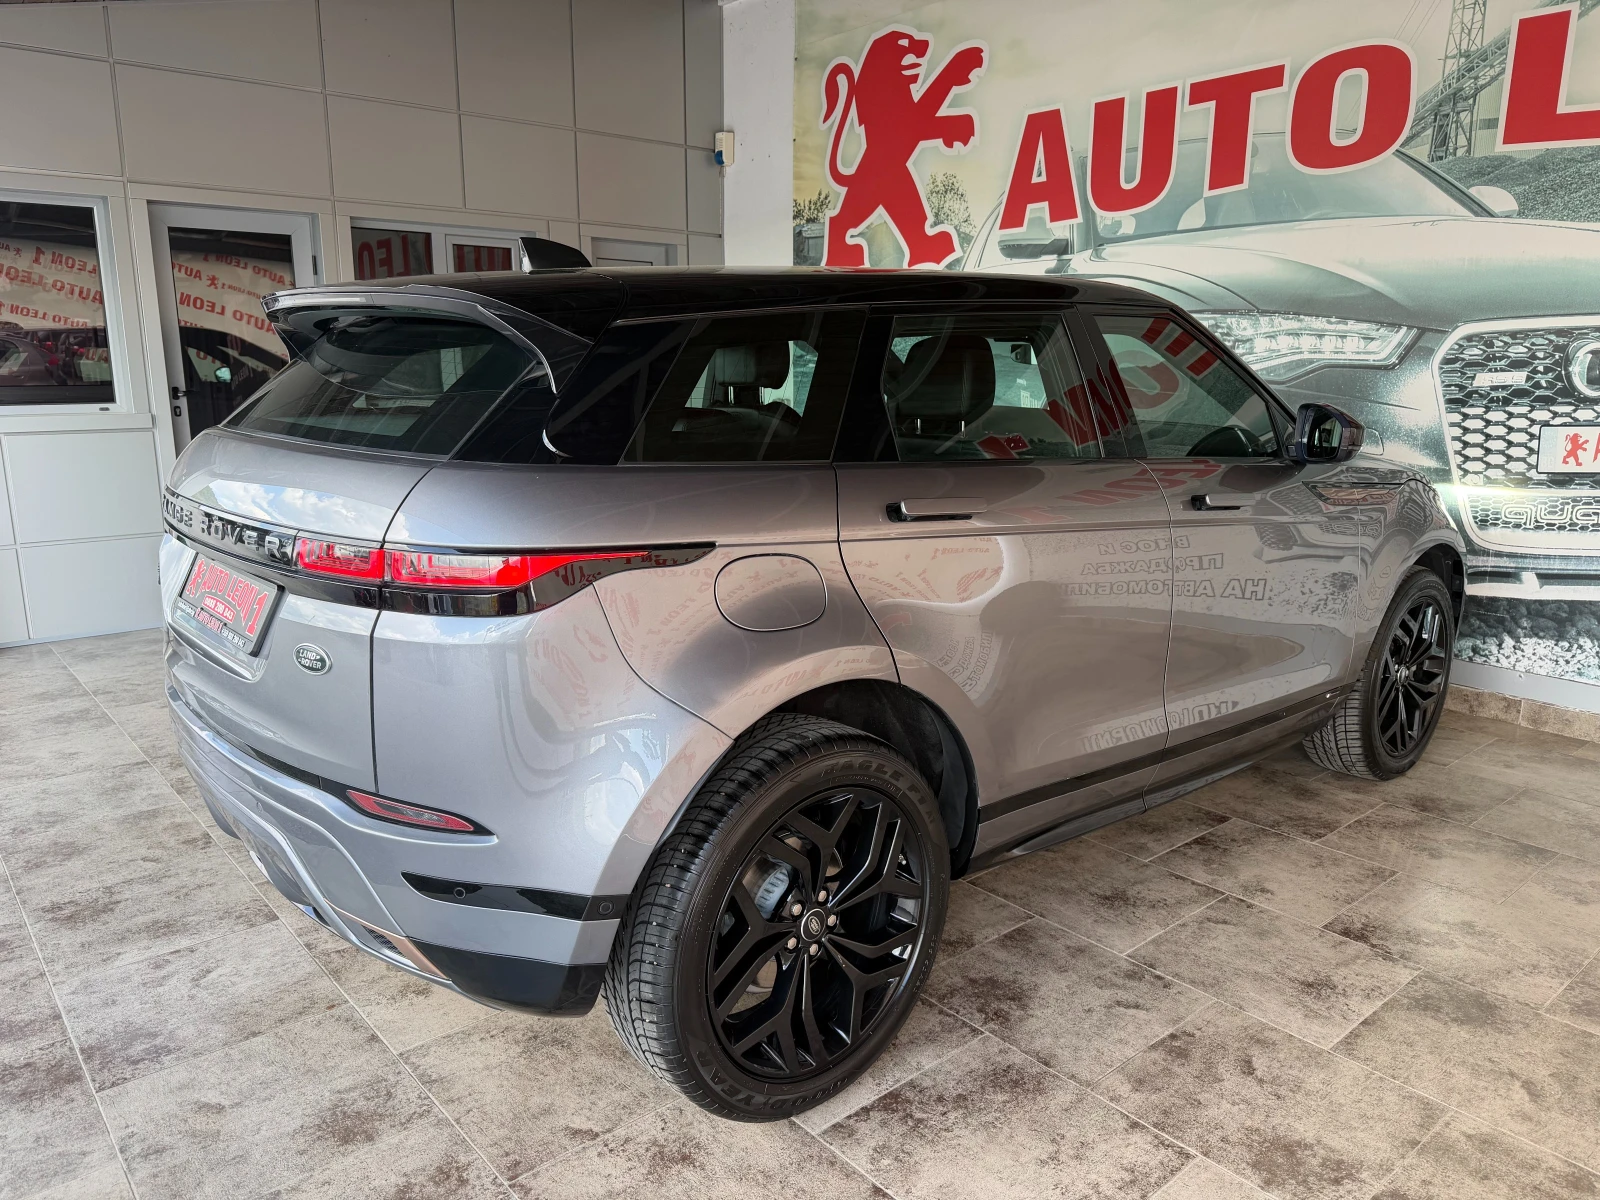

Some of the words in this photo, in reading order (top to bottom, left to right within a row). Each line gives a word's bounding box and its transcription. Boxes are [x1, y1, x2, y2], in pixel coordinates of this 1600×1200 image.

[997, 40, 1414, 232] AUTO
[1500, 8, 1600, 147] L
[200, 516, 283, 560] ROVER
[196, 563, 231, 598] AUTO
[224, 575, 260, 626] LEON
[245, 591, 269, 637] 1
[299, 649, 317, 660] LAND
[301, 657, 322, 670] ROVER
